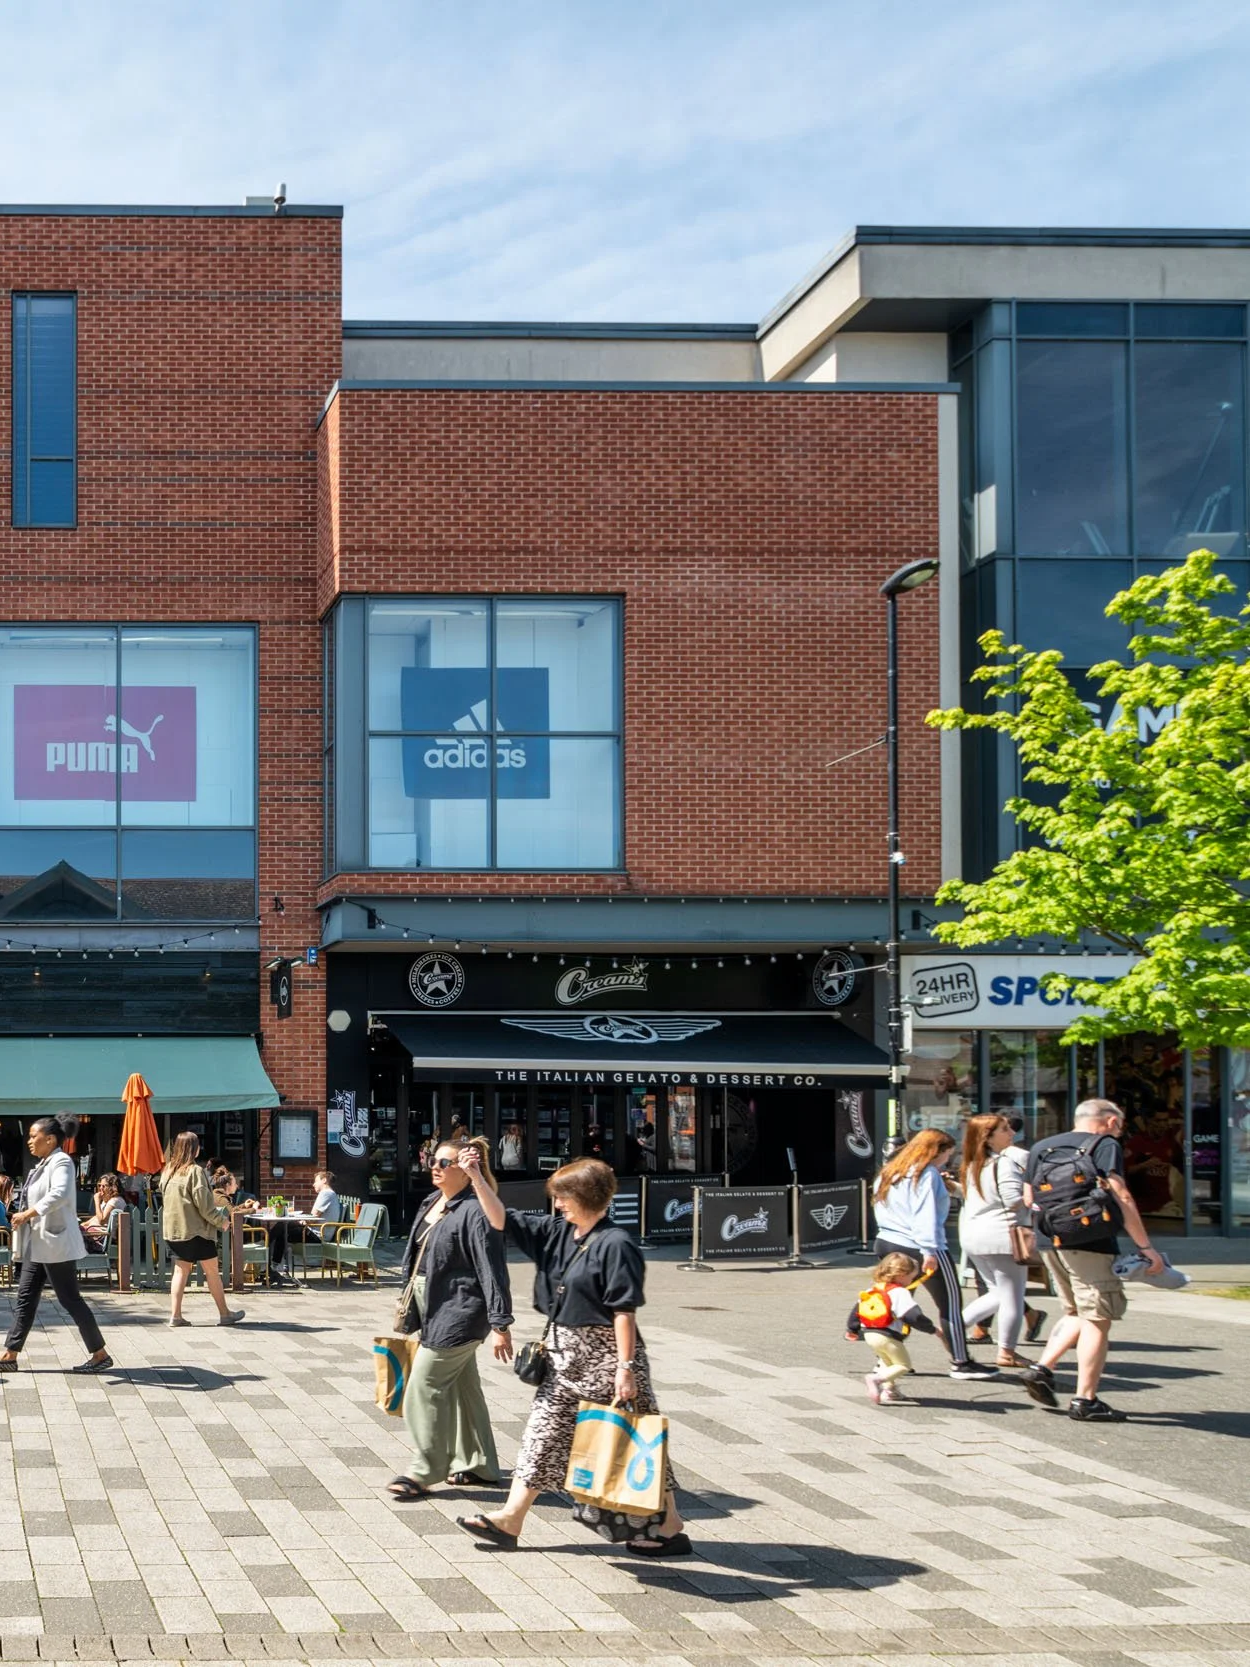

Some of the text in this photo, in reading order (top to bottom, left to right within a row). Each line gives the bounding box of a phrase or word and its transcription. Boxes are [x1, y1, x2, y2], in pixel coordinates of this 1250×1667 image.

[46, 742, 138, 773] PUMA
[423, 743, 527, 769] adidas
[916, 972, 970, 995] 24HR
[495, 1071, 823, 1086] THE ITALIAN GELATO & DESSERT CO.
[1193, 1134, 1220, 1143] GAME
